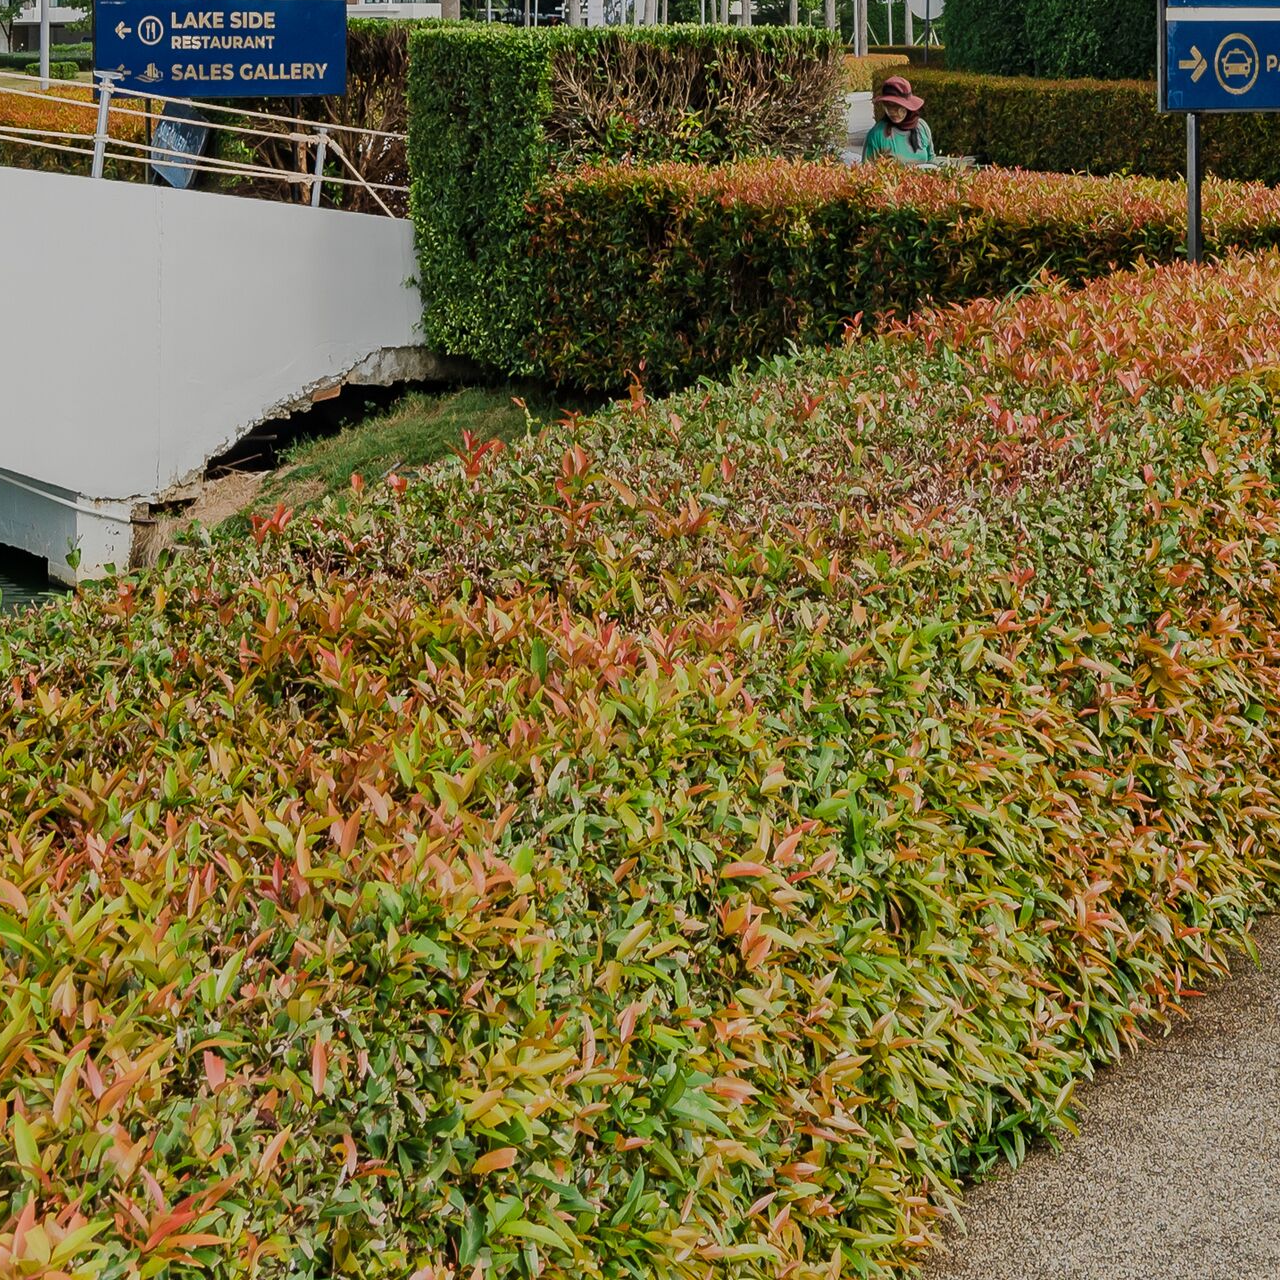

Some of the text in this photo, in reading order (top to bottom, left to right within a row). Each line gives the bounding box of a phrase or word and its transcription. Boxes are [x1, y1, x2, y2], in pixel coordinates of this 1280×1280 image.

[171, 11, 276, 29] LAKE SIDE
[171, 35, 275, 50] RESTAURANT
[171, 62, 328, 81] SALES GALLERY
